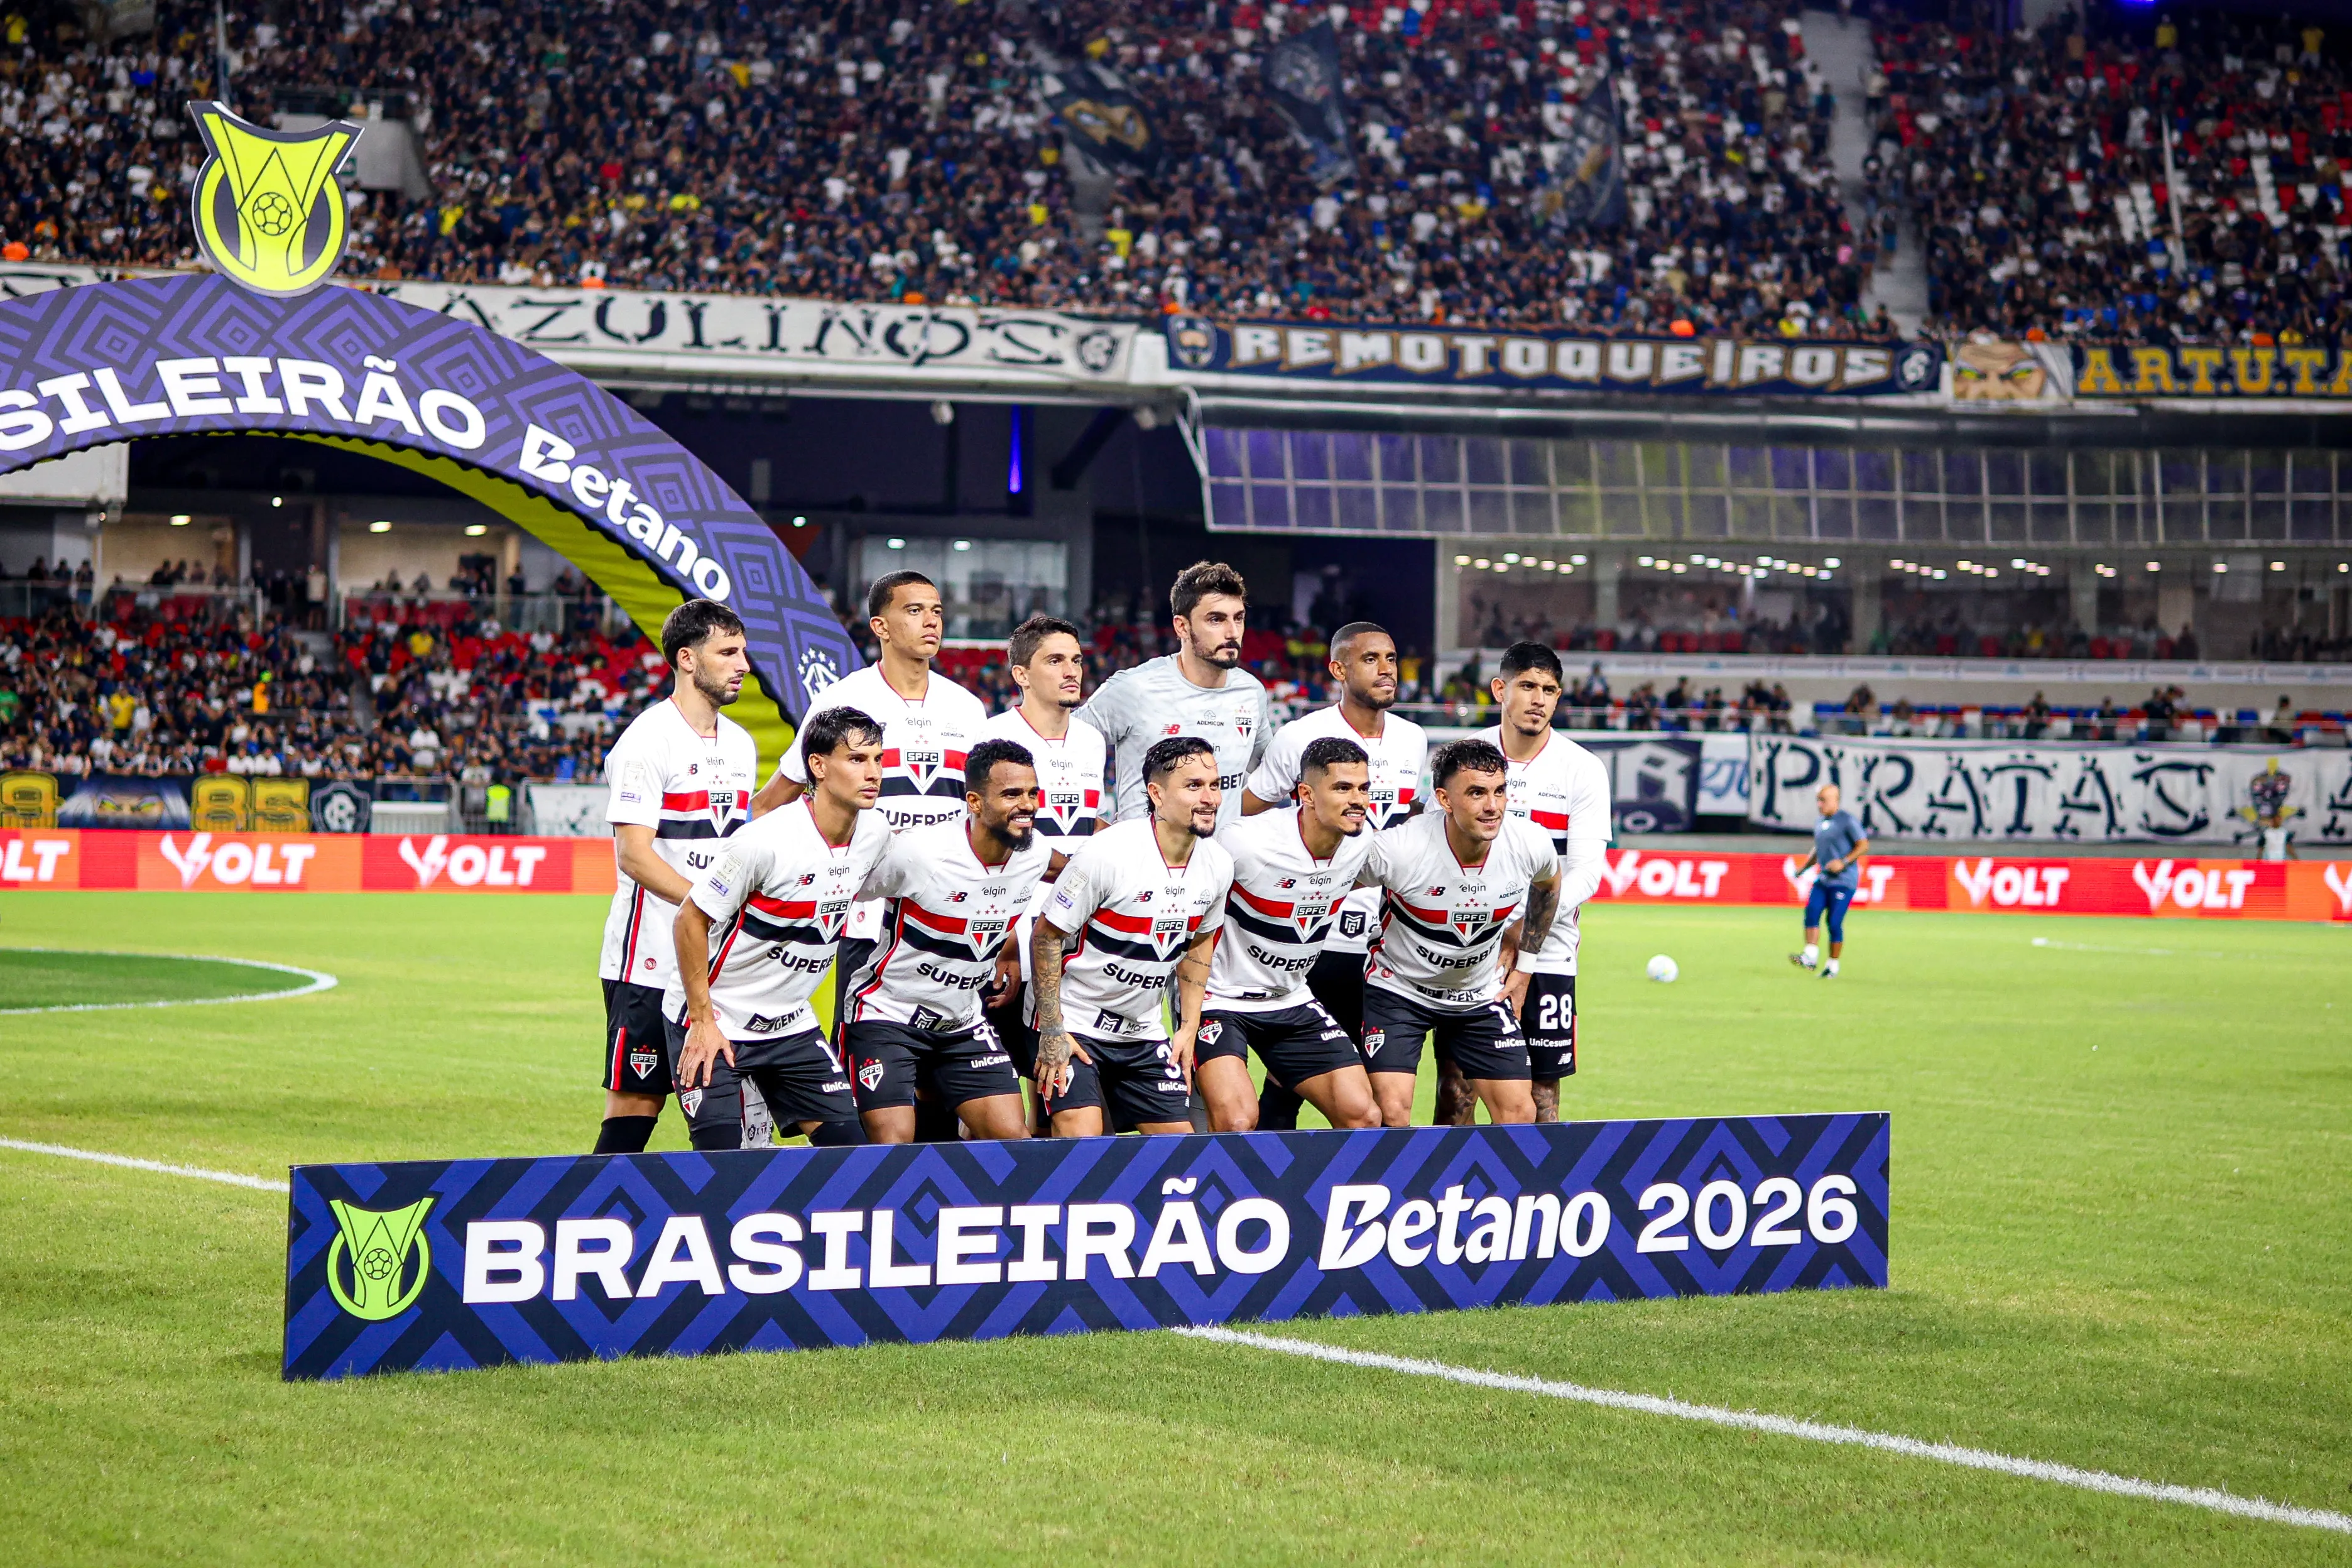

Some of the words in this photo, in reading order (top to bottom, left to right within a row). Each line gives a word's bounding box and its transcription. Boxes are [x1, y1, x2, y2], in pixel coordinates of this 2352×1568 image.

[1229, 324, 1892, 391] REMOTOQUEIROS
[518, 422, 731, 602] Betano
[907, 752, 939, 762] SPFC
[710, 793, 732, 803] SPFC
[1051, 794, 1079, 803] SPFC
[1538, 792, 1567, 800] ADEMICON
[160, 833, 316, 890] VOLT
[398, 835, 547, 889] VOLT
[1954, 858, 2070, 907] VOLT
[2132, 859, 2257, 912] VOLT
[1499, 888, 1525, 899] ADEMICON
[821, 901, 848, 913] SPFC
[1298, 906, 1327, 916] SPFC
[1454, 913, 1486, 922] SPFC
[973, 922, 1003, 931] SPFC
[1157, 921, 1183, 931] SPFC
[1540, 994, 1572, 1030] 28
[462, 1177, 1291, 1305] BRASILEIRÃO
[1318, 1183, 1611, 1271] Betano
[1636, 1174, 1858, 1254] 2026
